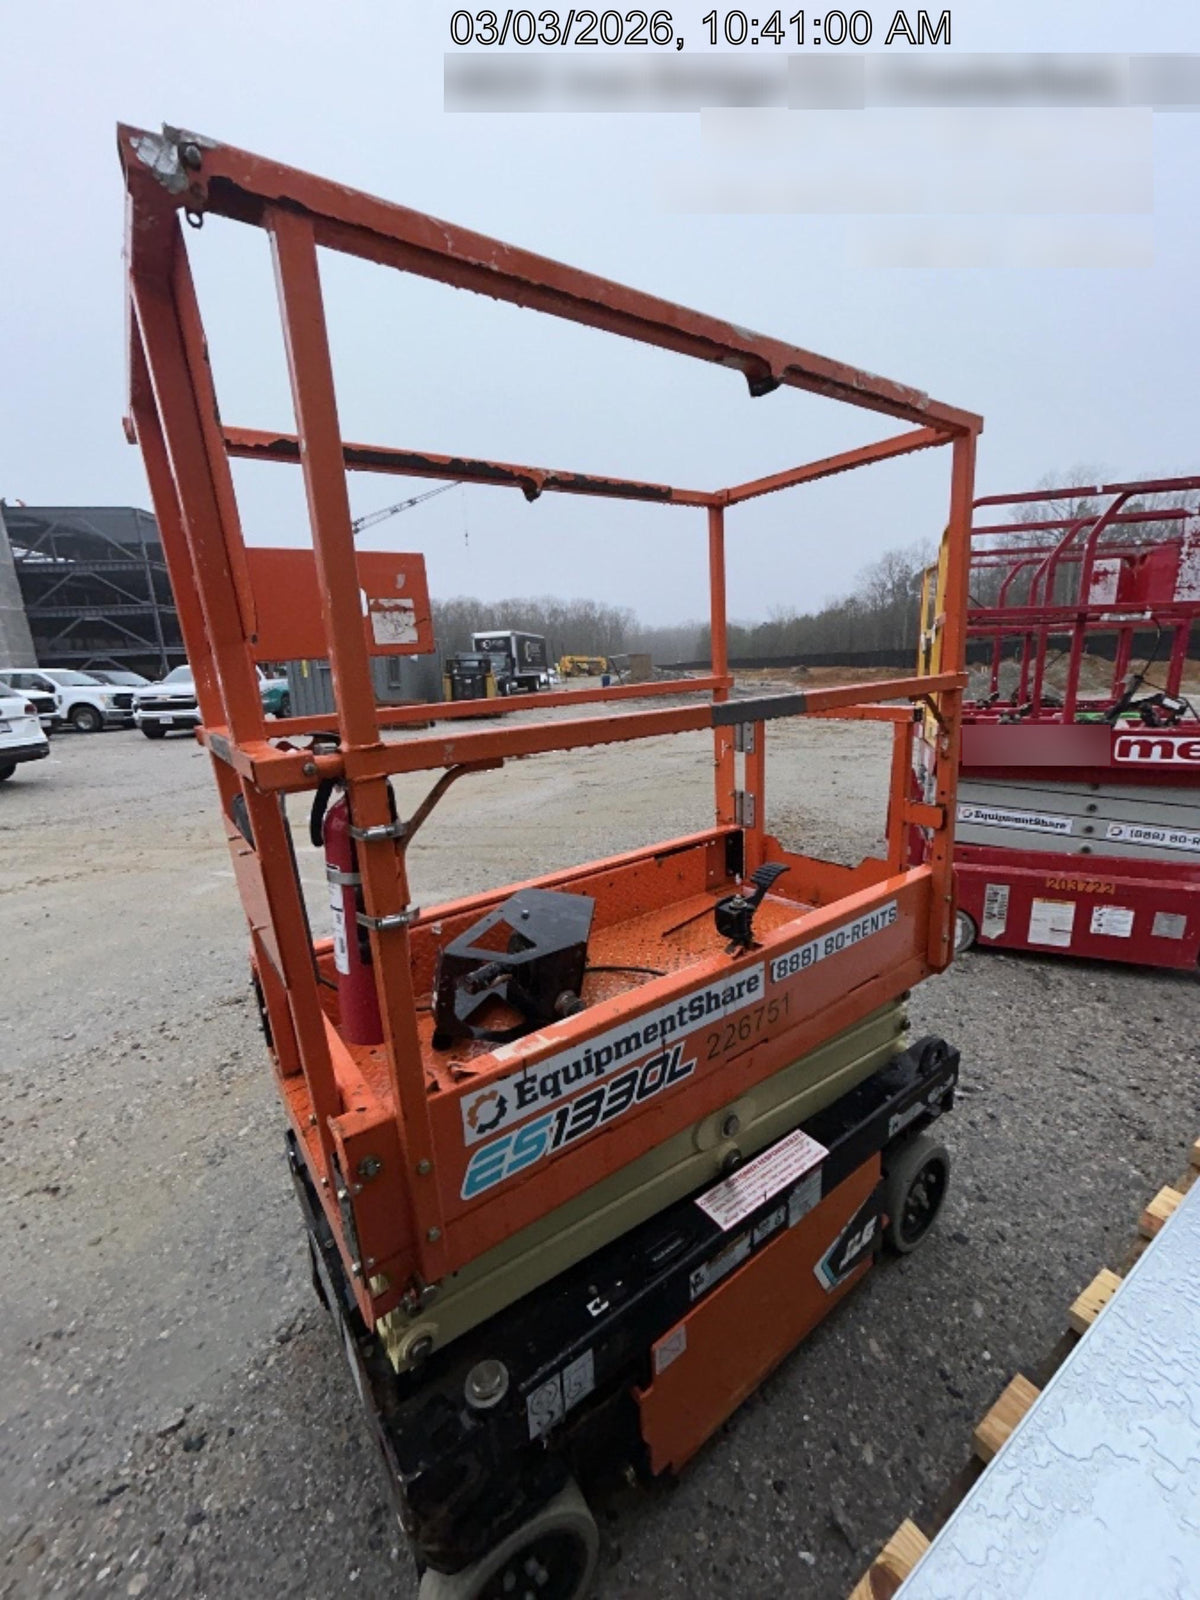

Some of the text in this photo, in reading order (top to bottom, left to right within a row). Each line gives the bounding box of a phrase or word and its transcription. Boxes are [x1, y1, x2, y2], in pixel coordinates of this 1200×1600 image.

[513, 906, 897, 1110] EquipmentShare (888) 80-RENTS
[706, 992, 789, 1060] 226751
[462, 1042, 697, 1199] ES1330L
